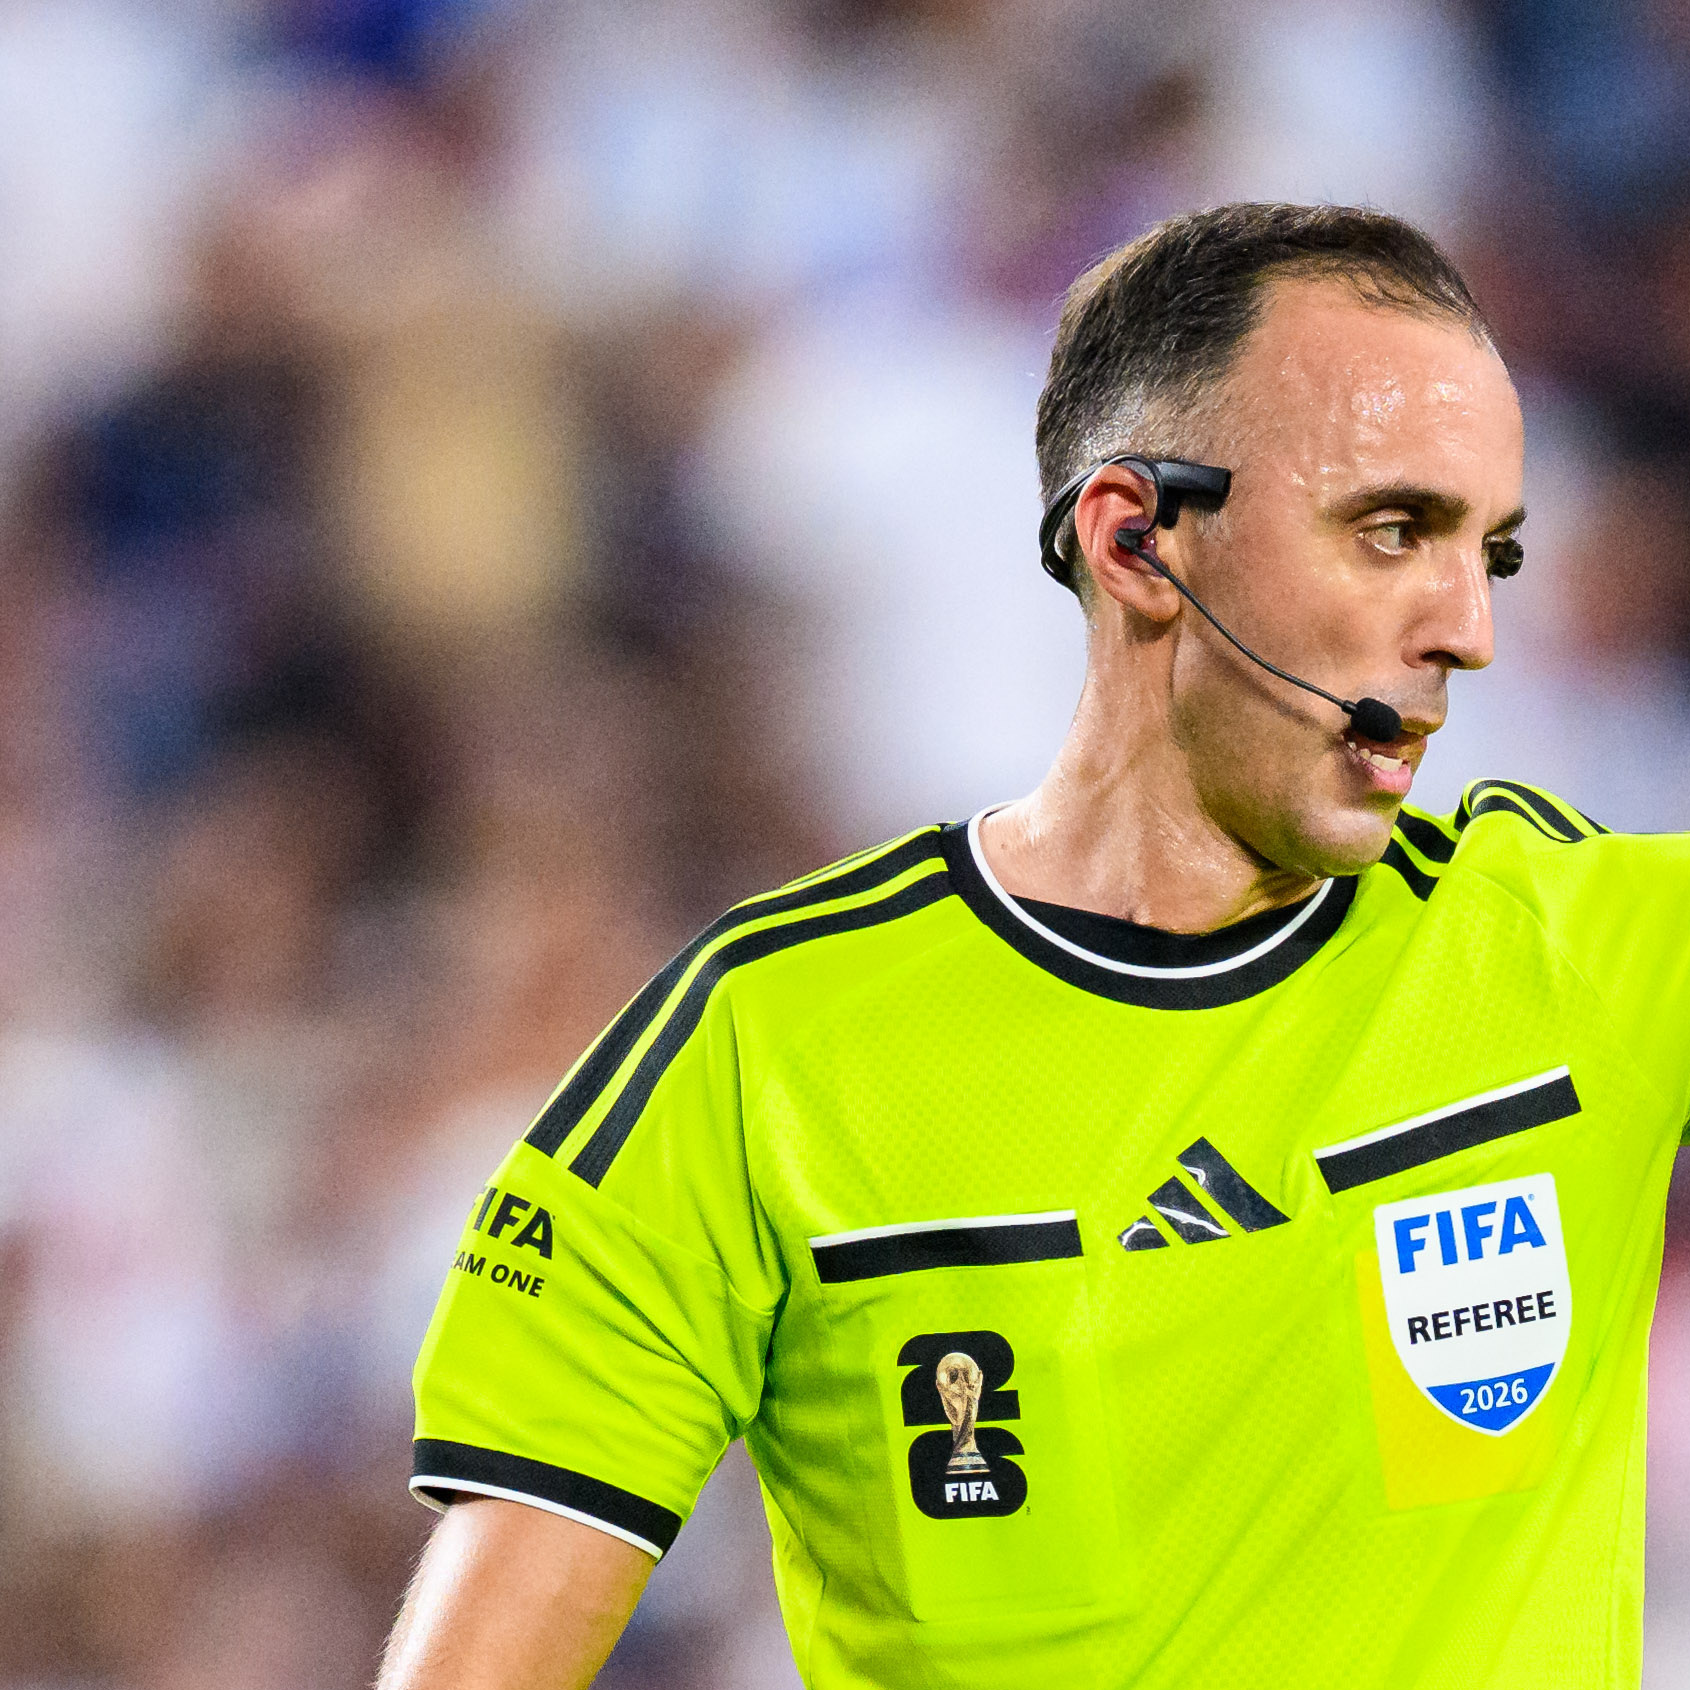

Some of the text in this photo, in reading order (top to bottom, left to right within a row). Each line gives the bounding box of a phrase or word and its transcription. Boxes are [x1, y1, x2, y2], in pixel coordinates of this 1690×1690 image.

[473, 1187, 554, 1260] IFA
[1393, 1195, 1547, 1274] FIFA
[490, 1263, 545, 1298] ONE
[1406, 1290, 1557, 1345] REFEREE
[1460, 1377, 1529, 1415] 2026
[944, 1481, 1000, 1503] FIFA
